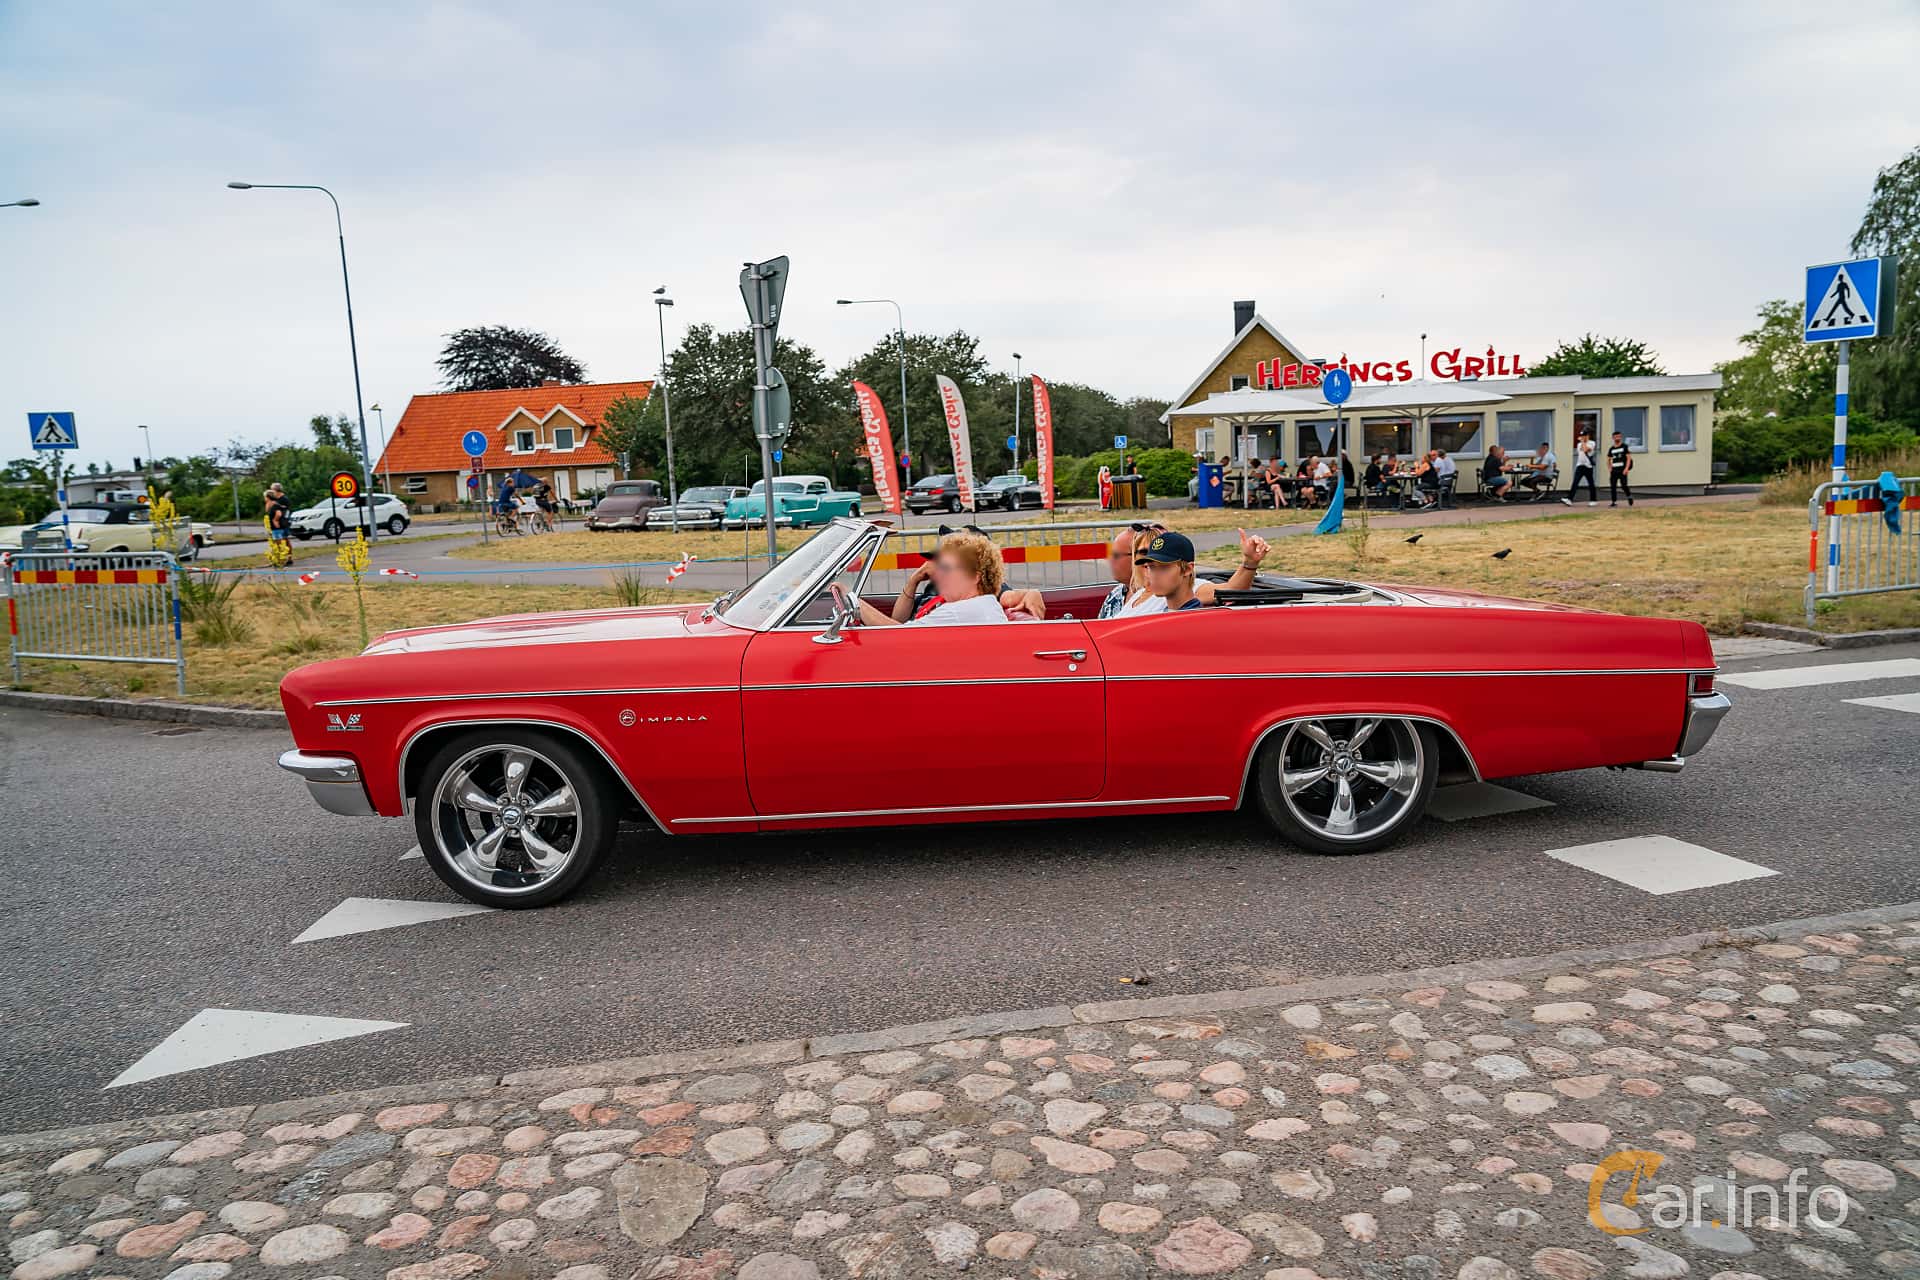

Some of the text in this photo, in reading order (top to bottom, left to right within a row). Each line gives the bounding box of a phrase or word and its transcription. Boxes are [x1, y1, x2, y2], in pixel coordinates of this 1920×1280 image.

[1431, 345, 1526, 381] GRILL
[337, 480, 353, 492] 30
[640, 715, 708, 723] IMPALA
